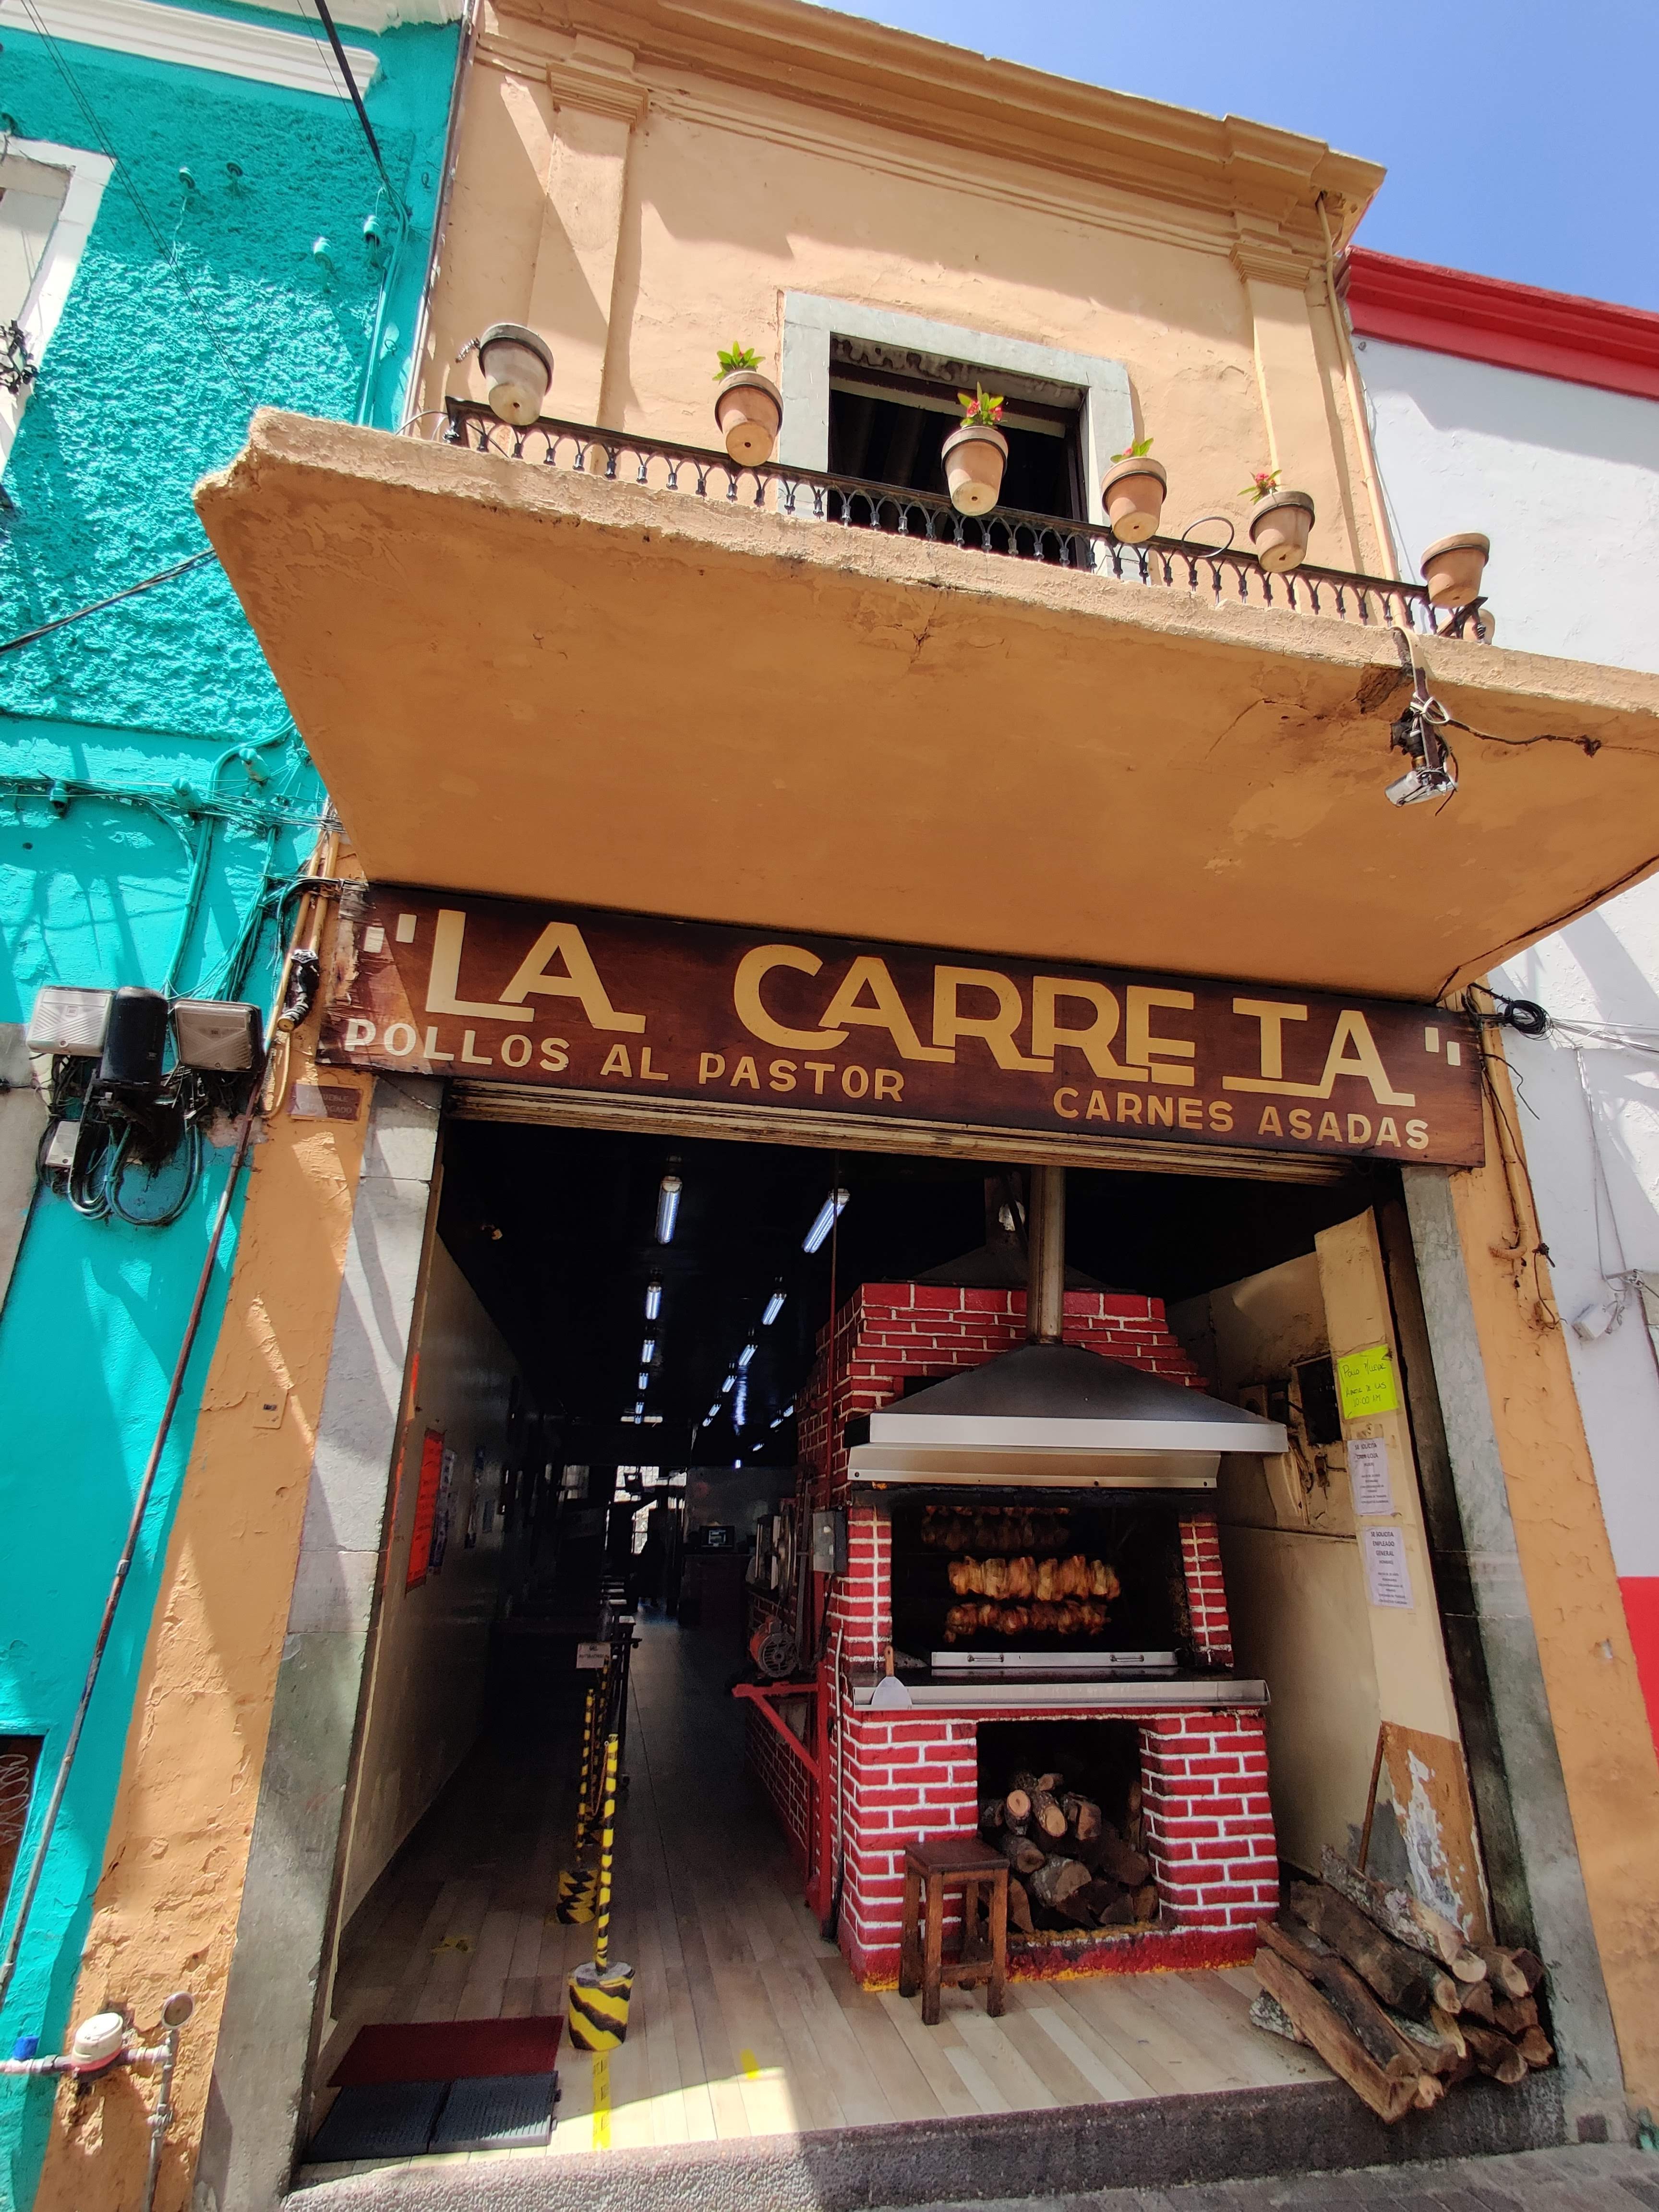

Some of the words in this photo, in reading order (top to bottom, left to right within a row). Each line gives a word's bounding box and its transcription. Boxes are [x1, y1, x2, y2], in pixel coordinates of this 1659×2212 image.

[345, 1019, 570, 1072] POLLOS
[600, 1043, 669, 1081] AL
[698, 1053, 904, 1103] PASTOR
[1053, 1087, 1233, 1132] CARNES
[1257, 1106, 1429, 1150] ASADAS
